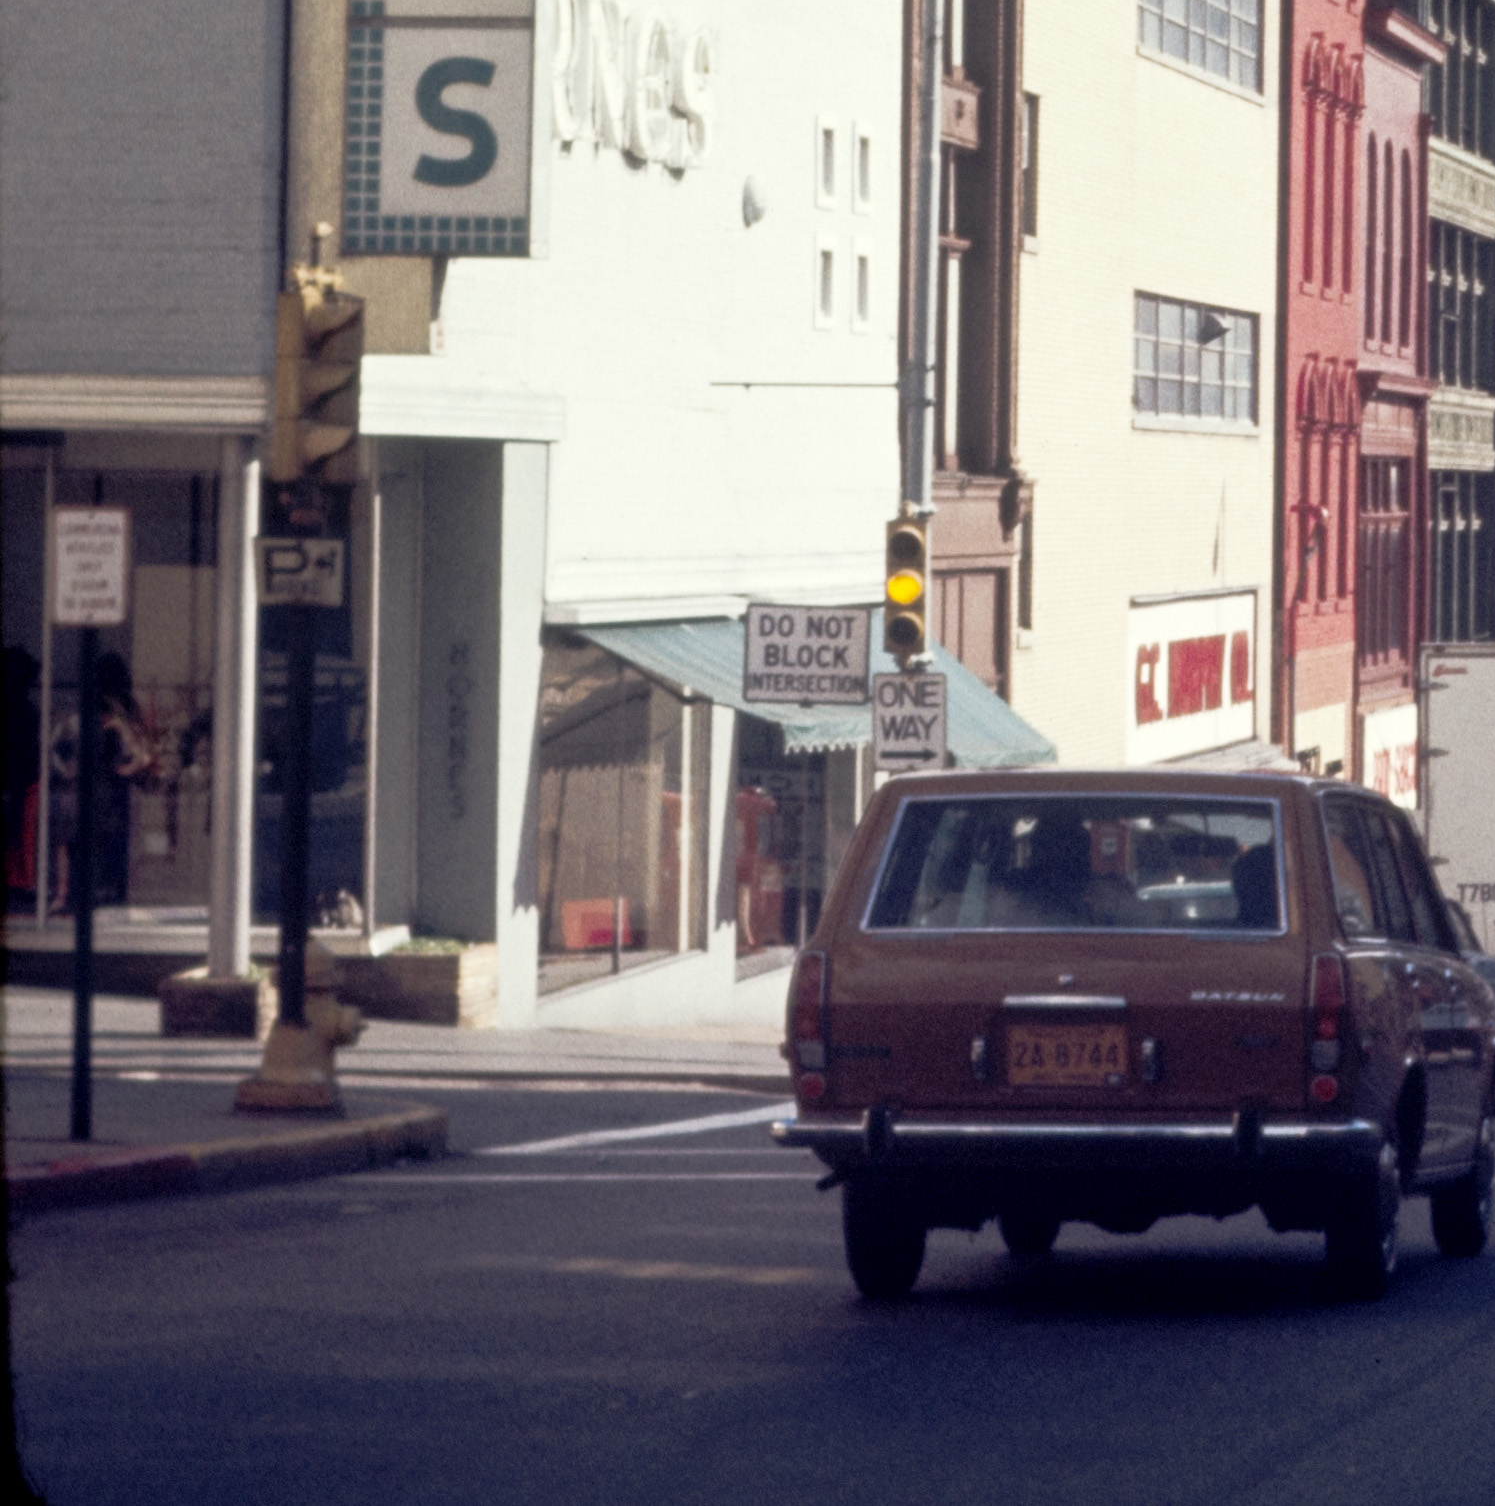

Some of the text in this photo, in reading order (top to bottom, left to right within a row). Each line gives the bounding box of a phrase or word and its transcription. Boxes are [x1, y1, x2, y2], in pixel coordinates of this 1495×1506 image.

[758, 614, 857, 640] DO NOT
[762, 643, 850, 669] BLOCK
[750, 673, 867, 694] INTERSECTION
[879, 681, 941, 708] ONE
[880, 714, 939, 741] WAY
[1189, 990, 1286, 1002] DATSUN
